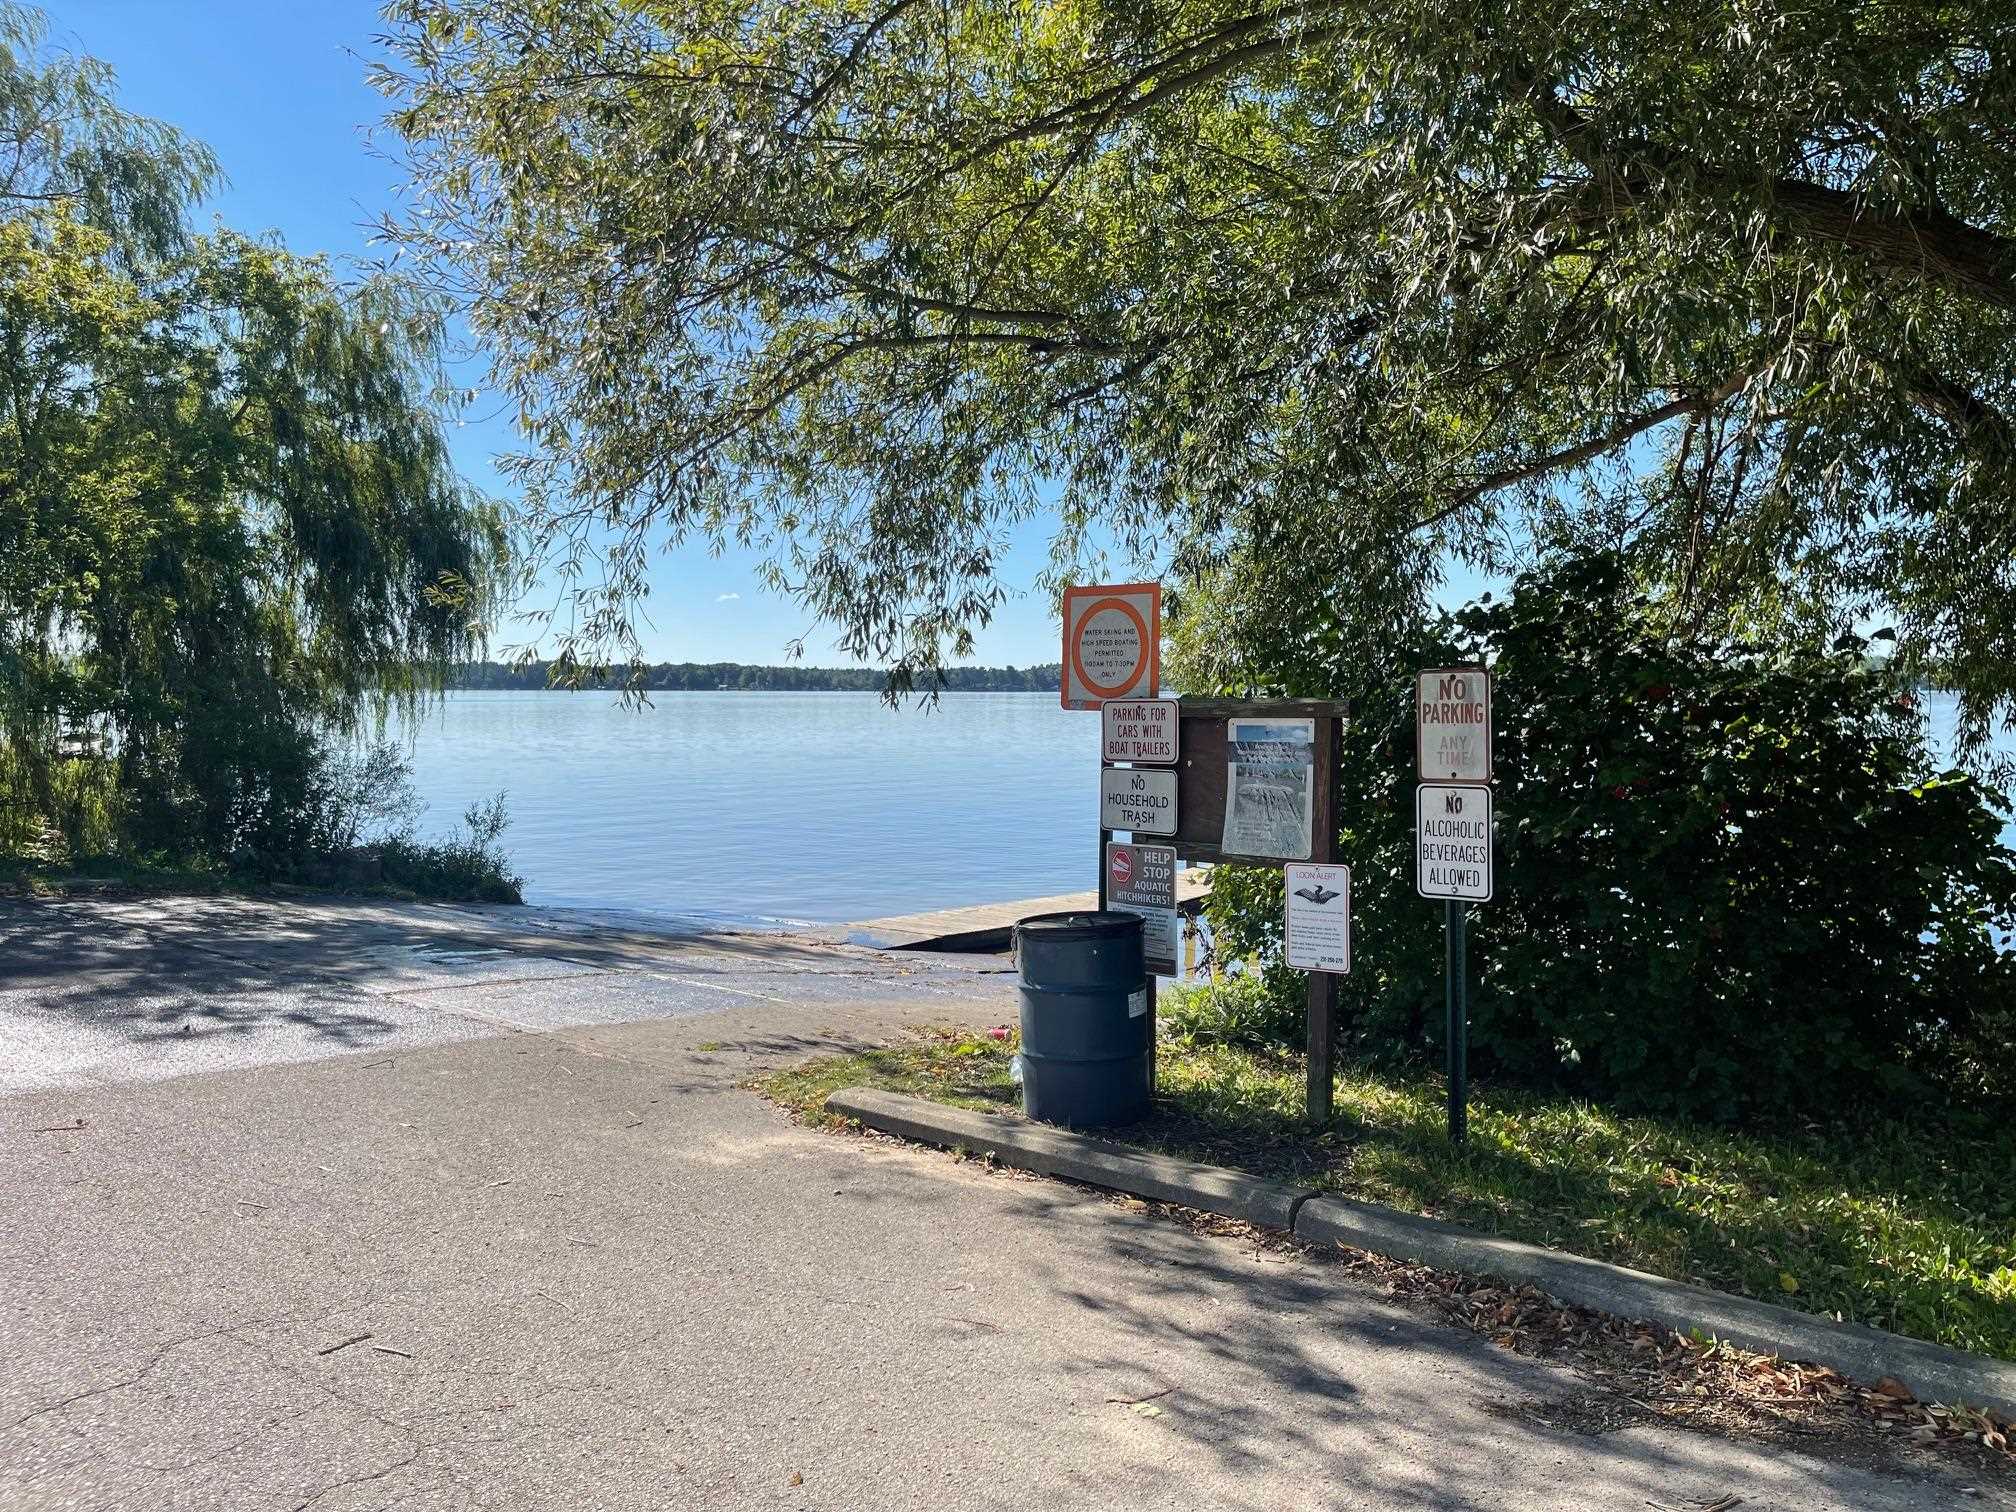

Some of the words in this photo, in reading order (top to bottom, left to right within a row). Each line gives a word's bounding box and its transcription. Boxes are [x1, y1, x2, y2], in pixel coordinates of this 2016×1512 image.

[1439, 679, 1466, 700] NO
[1112, 707, 1146, 721] PARKING
[1150, 707, 1167, 721] FOR
[1422, 703, 1484, 724] PARKING
[1117, 725, 1138, 738] CARS
[1142, 725, 1162, 738] WITH
[1109, 741, 1129, 755] BOAT
[1132, 741, 1170, 756] TRAILERS
[1440, 736, 1467, 750] ANY
[1437, 752, 1469, 767] TIME
[1131, 778, 1146, 791] NO
[1108, 793, 1169, 809] HOUSEHOLD
[1445, 796, 1463, 814] NO
[1121, 809, 1155, 824] TRASH
[1424, 820, 1485, 839] ALCOHOLIC
[1144, 851, 1170, 865] HELP
[1422, 843, 1487, 864] BEVERAGES
[1143, 866, 1171, 880] STOP
[1296, 871, 1316, 880] LOON
[1316, 872, 1336, 880] ALERT
[1429, 867, 1480, 887] ALLOWED
[1134, 880, 1171, 893] AQUATIC
[1116, 890, 1170, 905] HITCHHIKERS!
